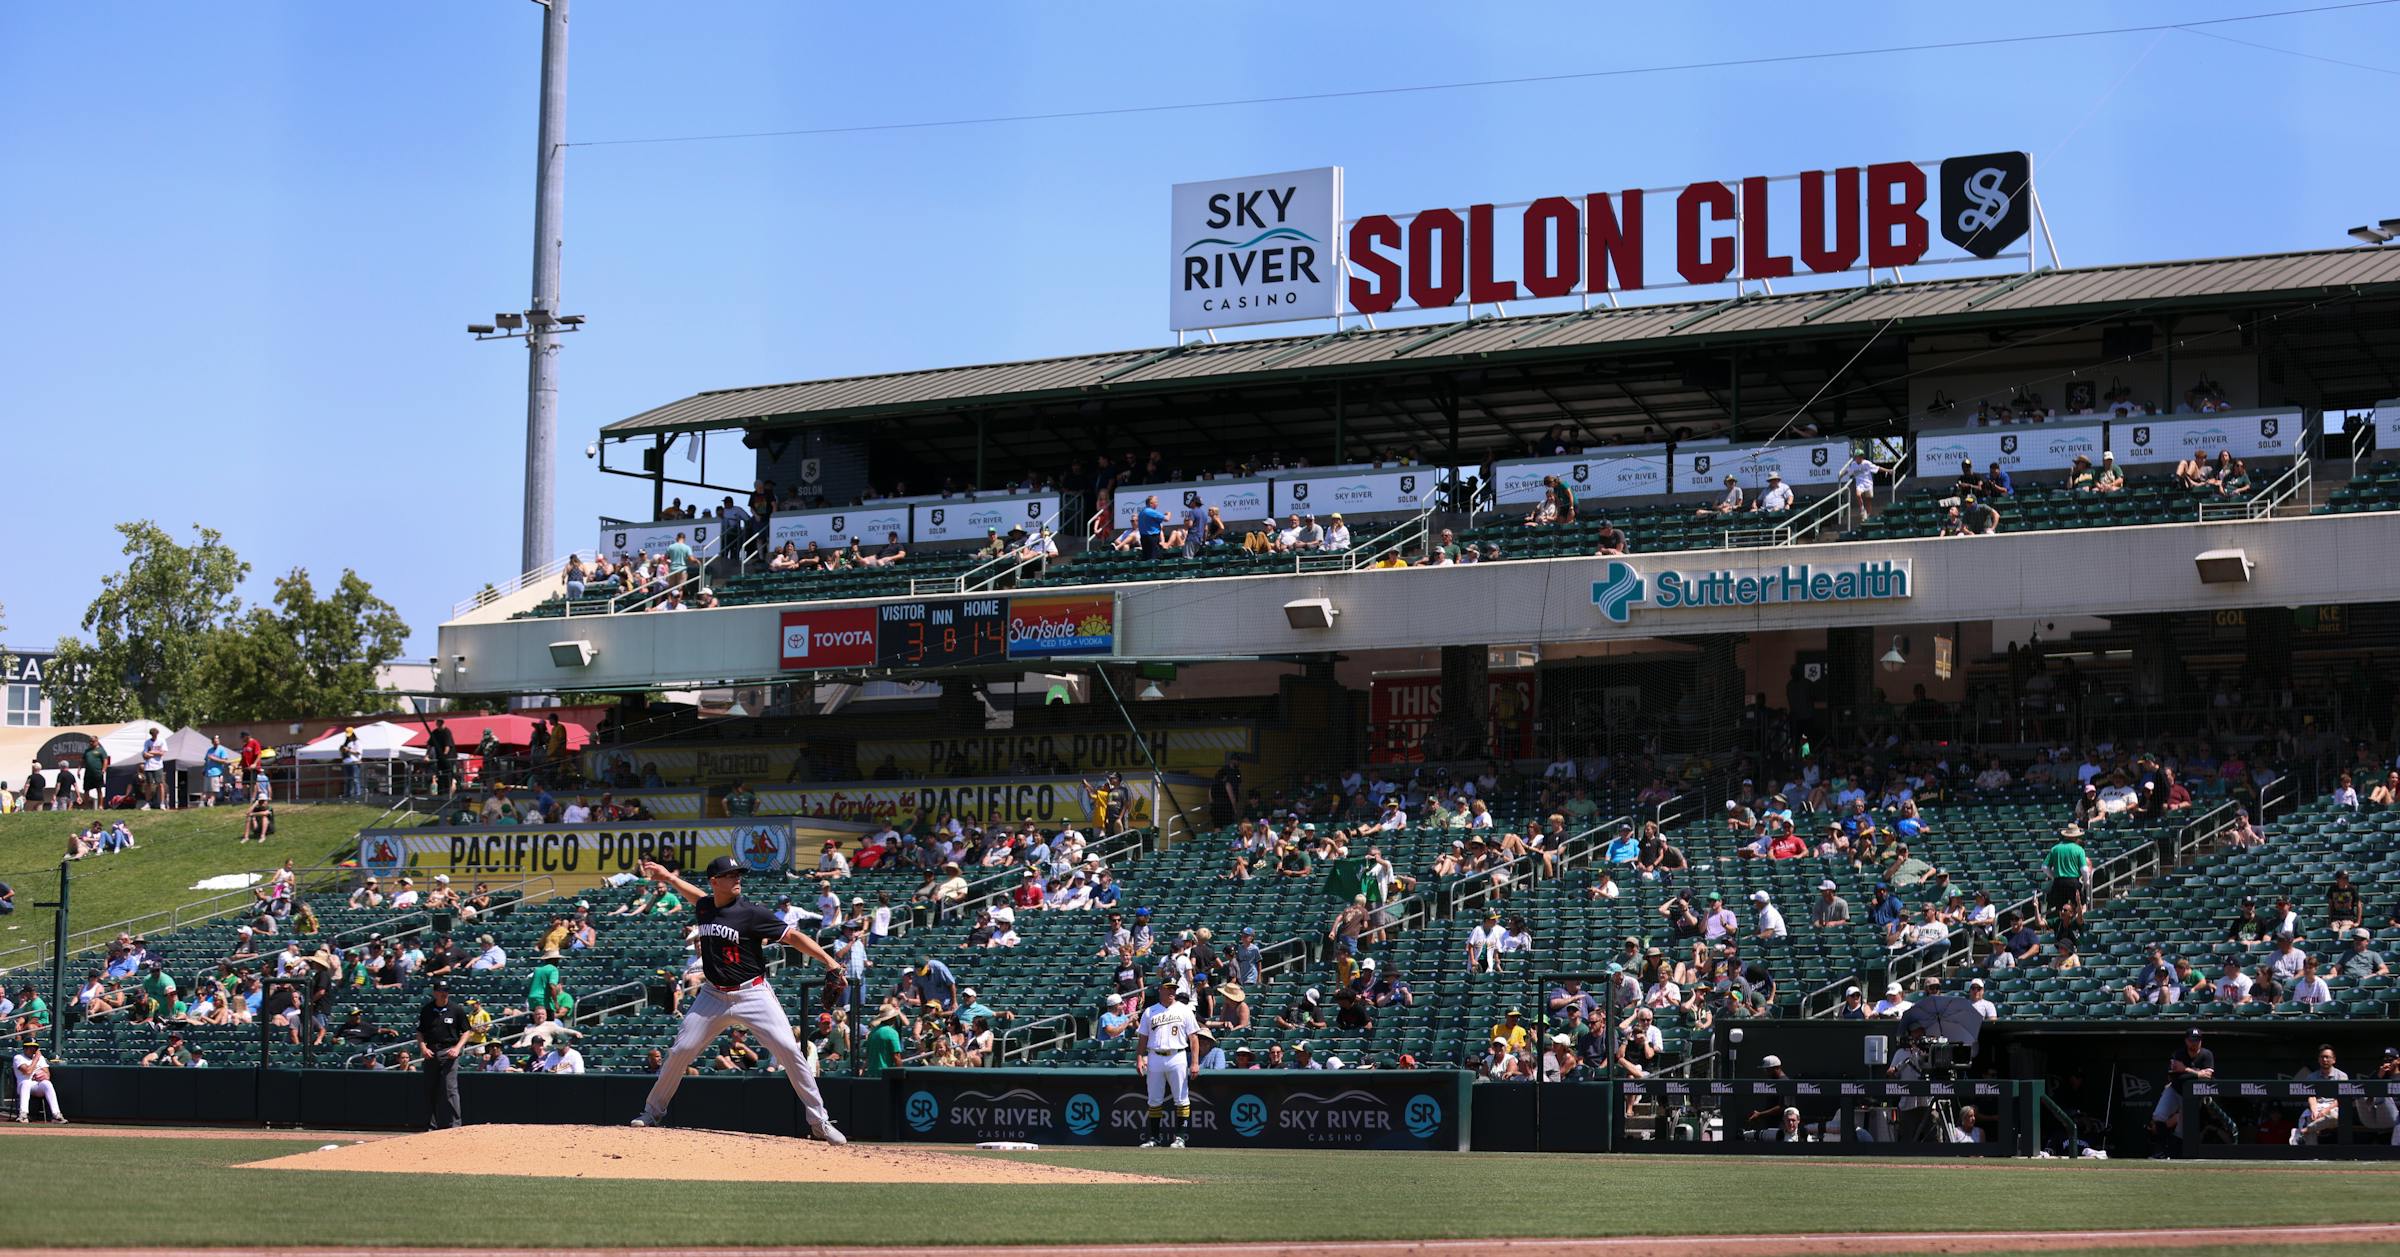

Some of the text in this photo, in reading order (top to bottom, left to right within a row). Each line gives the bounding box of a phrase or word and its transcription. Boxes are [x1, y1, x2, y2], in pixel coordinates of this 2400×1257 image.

[1206, 186, 1297, 229] SKY
[1349, 161, 1930, 315] SOLON CLUB
[1184, 245, 1320, 292] RIVER
[1203, 292, 1297, 312] CASINO
[1656, 560, 1907, 609] Sutter Health
[882, 604, 925, 621] VISITOR
[932, 609, 953, 625] INN
[963, 600, 999, 617] HOME
[813, 630, 873, 647] TOYOTA
[944, 627, 956, 653] 8
[973, 620, 1005, 656] 14
[1009, 617, 1075, 643] Surfside
[907, 622, 924, 661] 3
[1040, 638, 1103, 648] ICED TEA VODKA
[930, 731, 1168, 773] PACIFICO PORCH
[920, 784, 1055, 822] PACIFICO
[450, 830, 698, 874] PACIFICO PORCH
[1171, 1025, 1179, 1036] 8
[911, 1100, 934, 1118] SR
[950, 1106, 1053, 1129] SKY RIVER
[1071, 1102, 1094, 1120] SR
[1110, 1109, 1218, 1131] SKY RIER
[1236, 1103, 1261, 1123] SR
[1279, 1109, 1392, 1131] SKY RIVER
[1411, 1103, 1436, 1123] SR
[978, 1130, 1025, 1139] CASINO
[1308, 1133, 1362, 1143] CASINO
